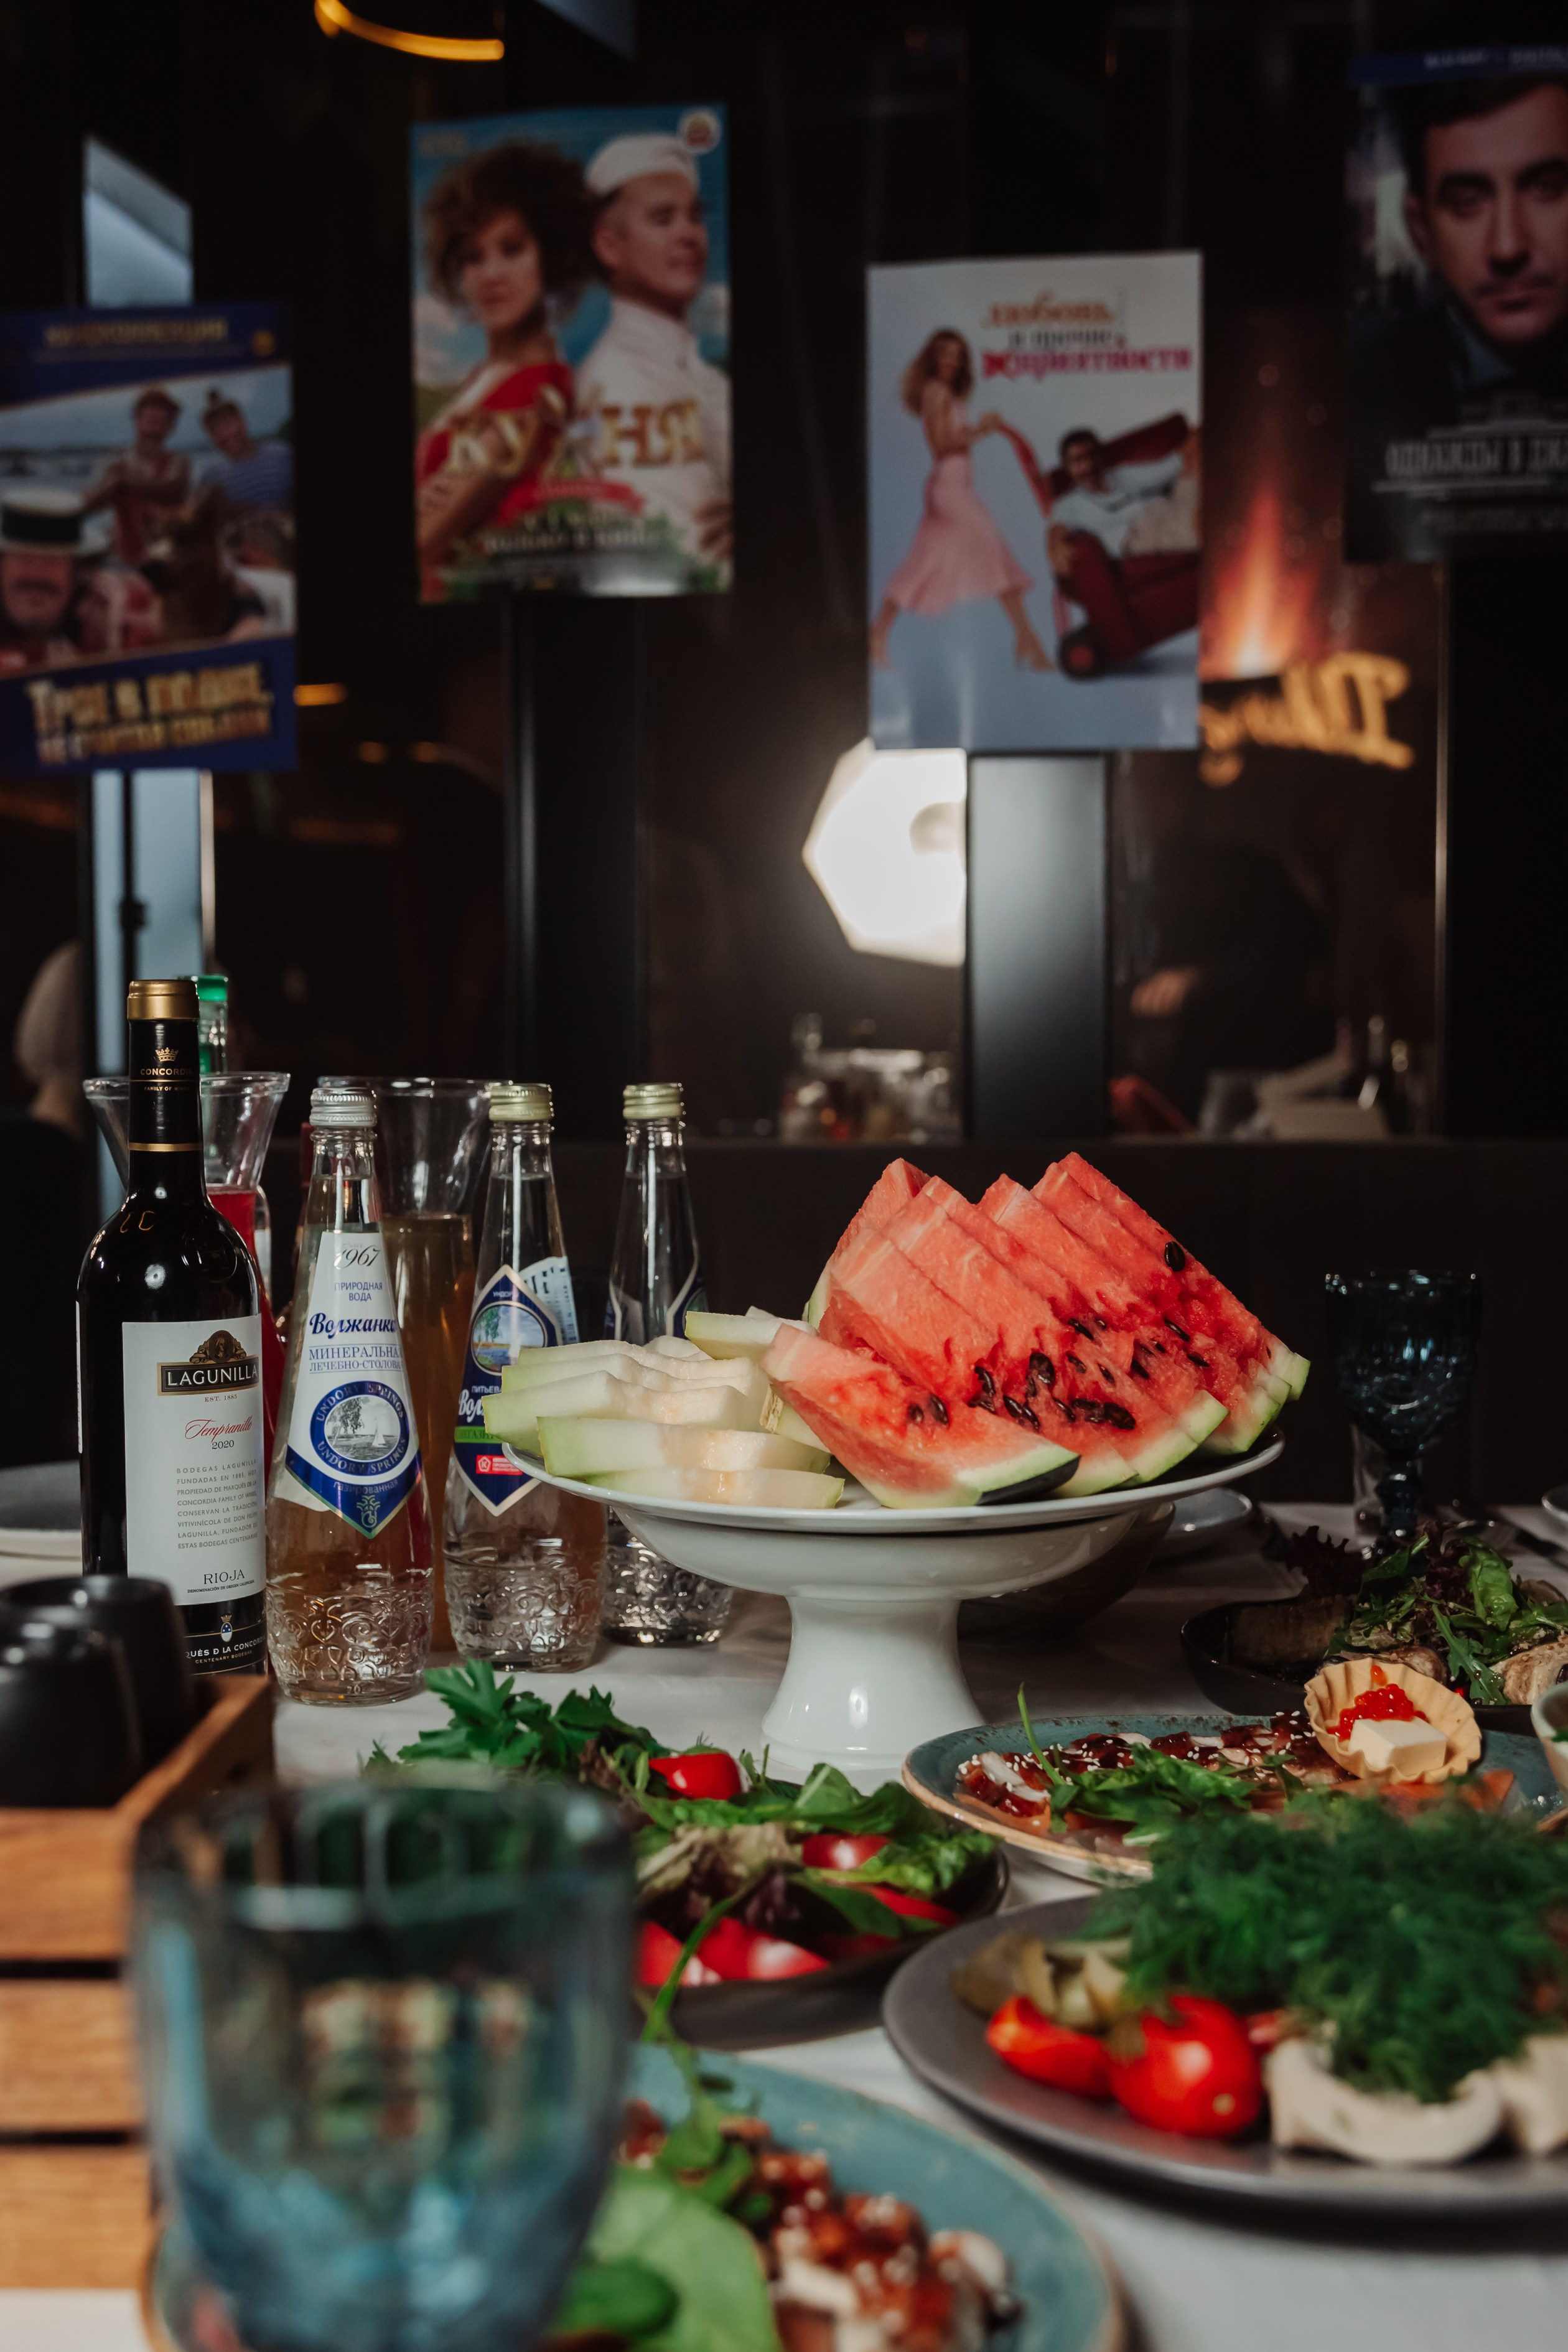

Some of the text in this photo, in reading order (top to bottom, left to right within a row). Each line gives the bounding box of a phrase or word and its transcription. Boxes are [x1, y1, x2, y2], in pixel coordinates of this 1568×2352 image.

[140, 1068, 194, 1076] CONCORDIA
[334, 1282, 383, 1291] ПРИРОДНАЯ
[348, 1292, 371, 1301] ВОДА
[309, 1346, 403, 1360] МИНЕРАЛЬНА
[309, 1360, 402, 1371] ЛЕЧЕБНО-СТОЛОВА
[167, 1365, 258, 1386] LAGUNILLA
[316, 1382, 404, 1421] UNDORY SPRINGS
[459, 1389, 484, 1422] Вол
[185, 1416, 253, 1443] Tempranillo
[212, 1440, 235, 1450] 2020
[370, 1437, 406, 1473] SPRINGS
[222, 1458, 256, 1470] LAGUNILLA
[177, 1508, 220, 1516] CONSERVAN
[177, 1519, 221, 1527] VITIVINÍCOLA
[222, 1524, 251, 1534] FUNDADOR
[199, 1539, 228, 1547] BODEGAS
[203, 1569, 245, 1585] RIOJA
[195, 1650, 253, 1664] CENTENARY BODEGAS
